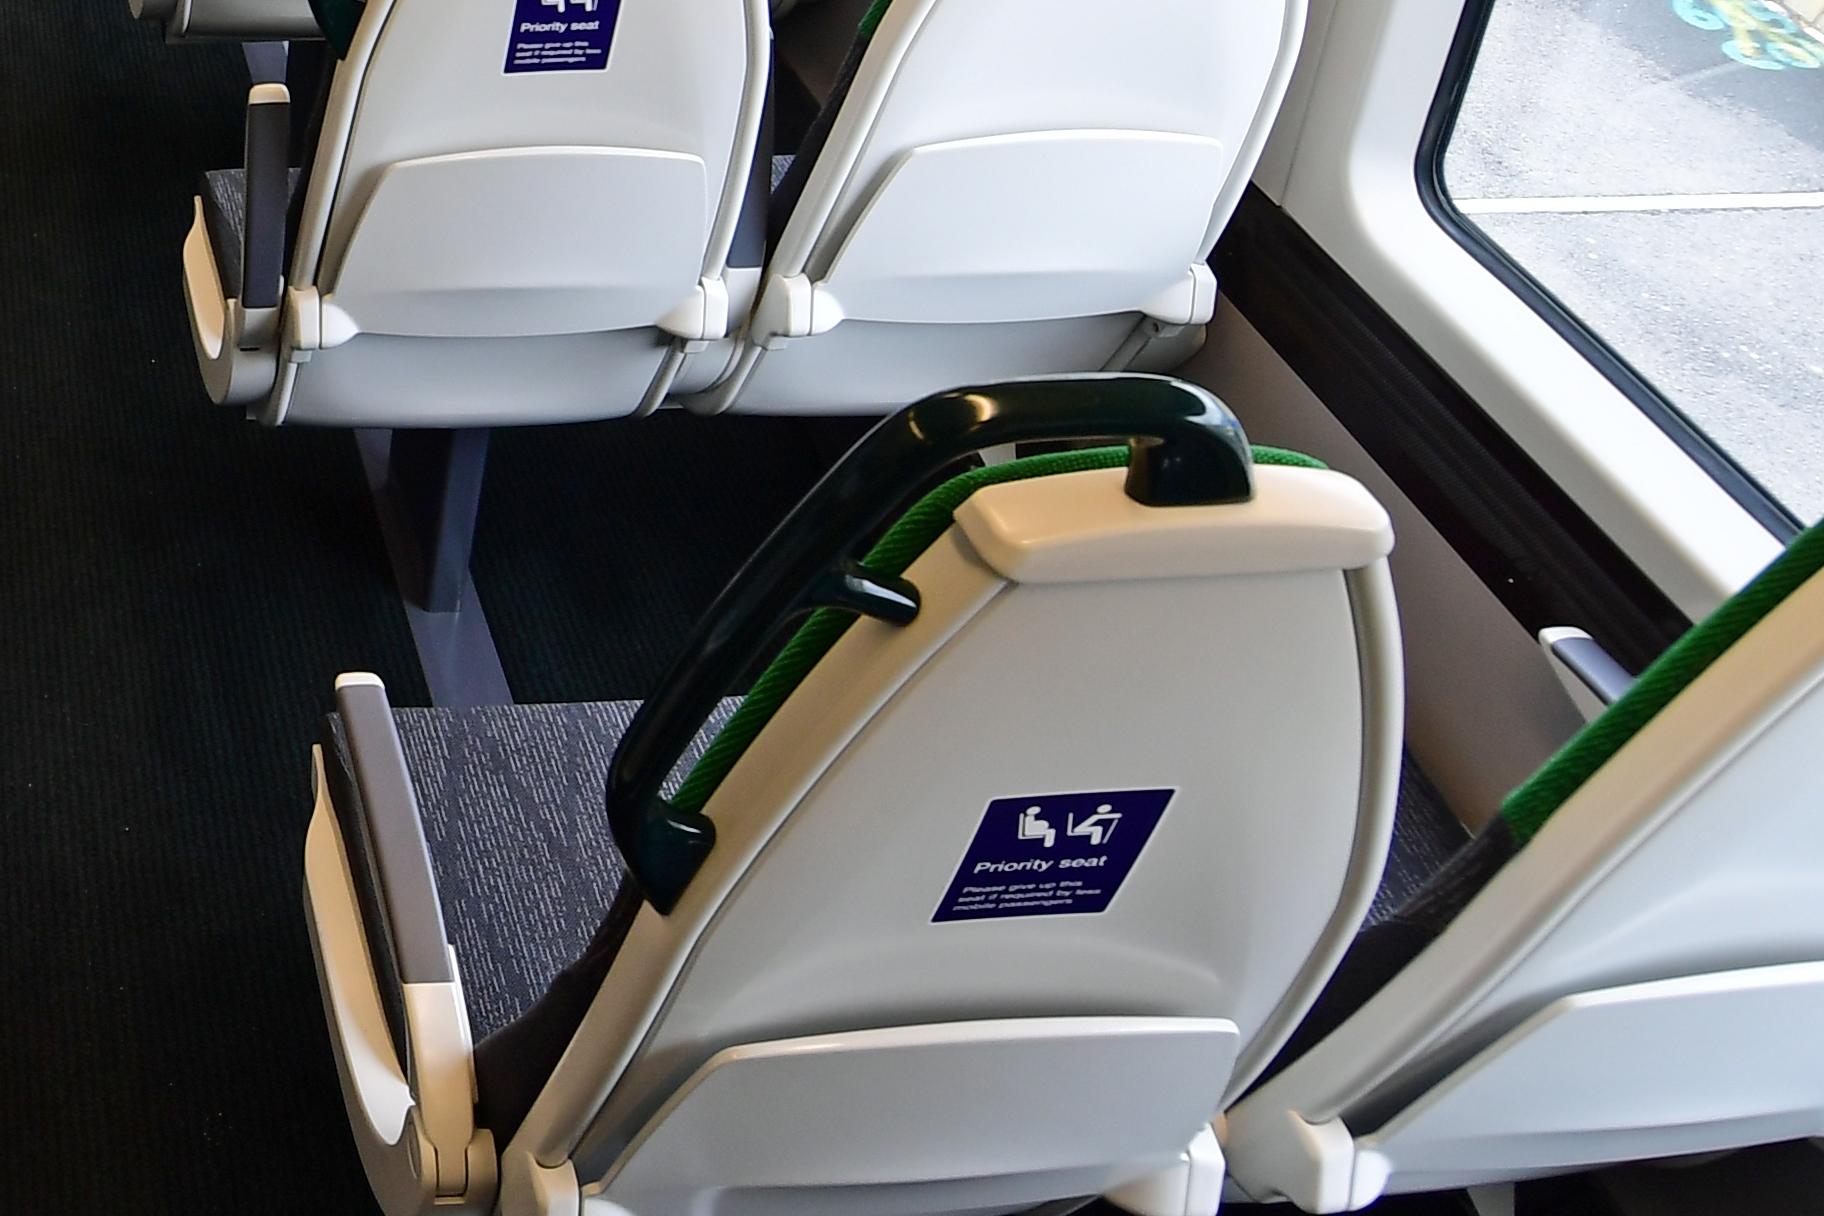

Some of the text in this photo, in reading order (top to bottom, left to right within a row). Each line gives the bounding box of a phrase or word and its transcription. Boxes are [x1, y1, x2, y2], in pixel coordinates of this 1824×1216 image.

[520, 20, 600, 34] Priority seat
[973, 855, 1108, 874] Priority seat
[962, 885, 1007, 894] Please
[1008, 883, 1036, 892] give
[957, 894, 986, 902] seat
[999, 890, 1054, 900] required
[1056, 889, 1074, 897] by
[952, 899, 1073, 911] mobile passengers
